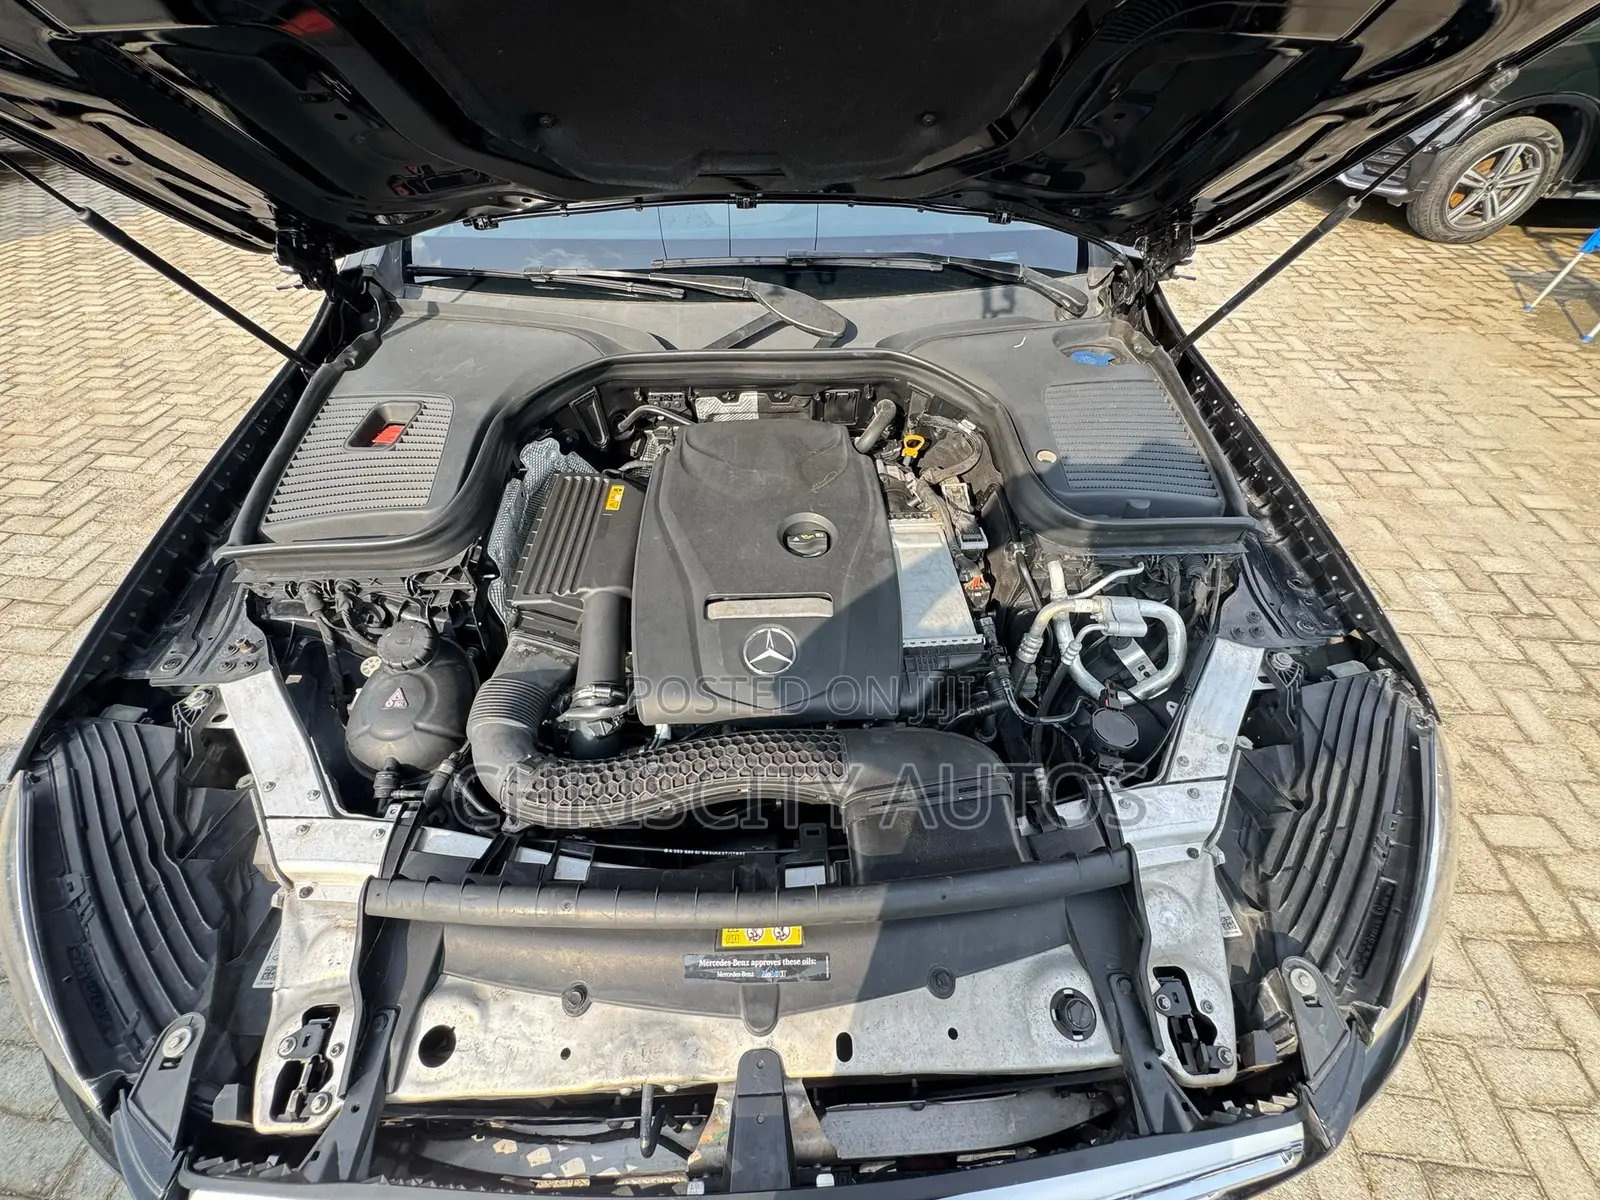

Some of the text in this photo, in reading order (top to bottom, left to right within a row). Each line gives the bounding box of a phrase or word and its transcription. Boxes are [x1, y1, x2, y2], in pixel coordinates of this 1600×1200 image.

[699, 958, 817, 969] Mercedes-Benz approves these oils:
